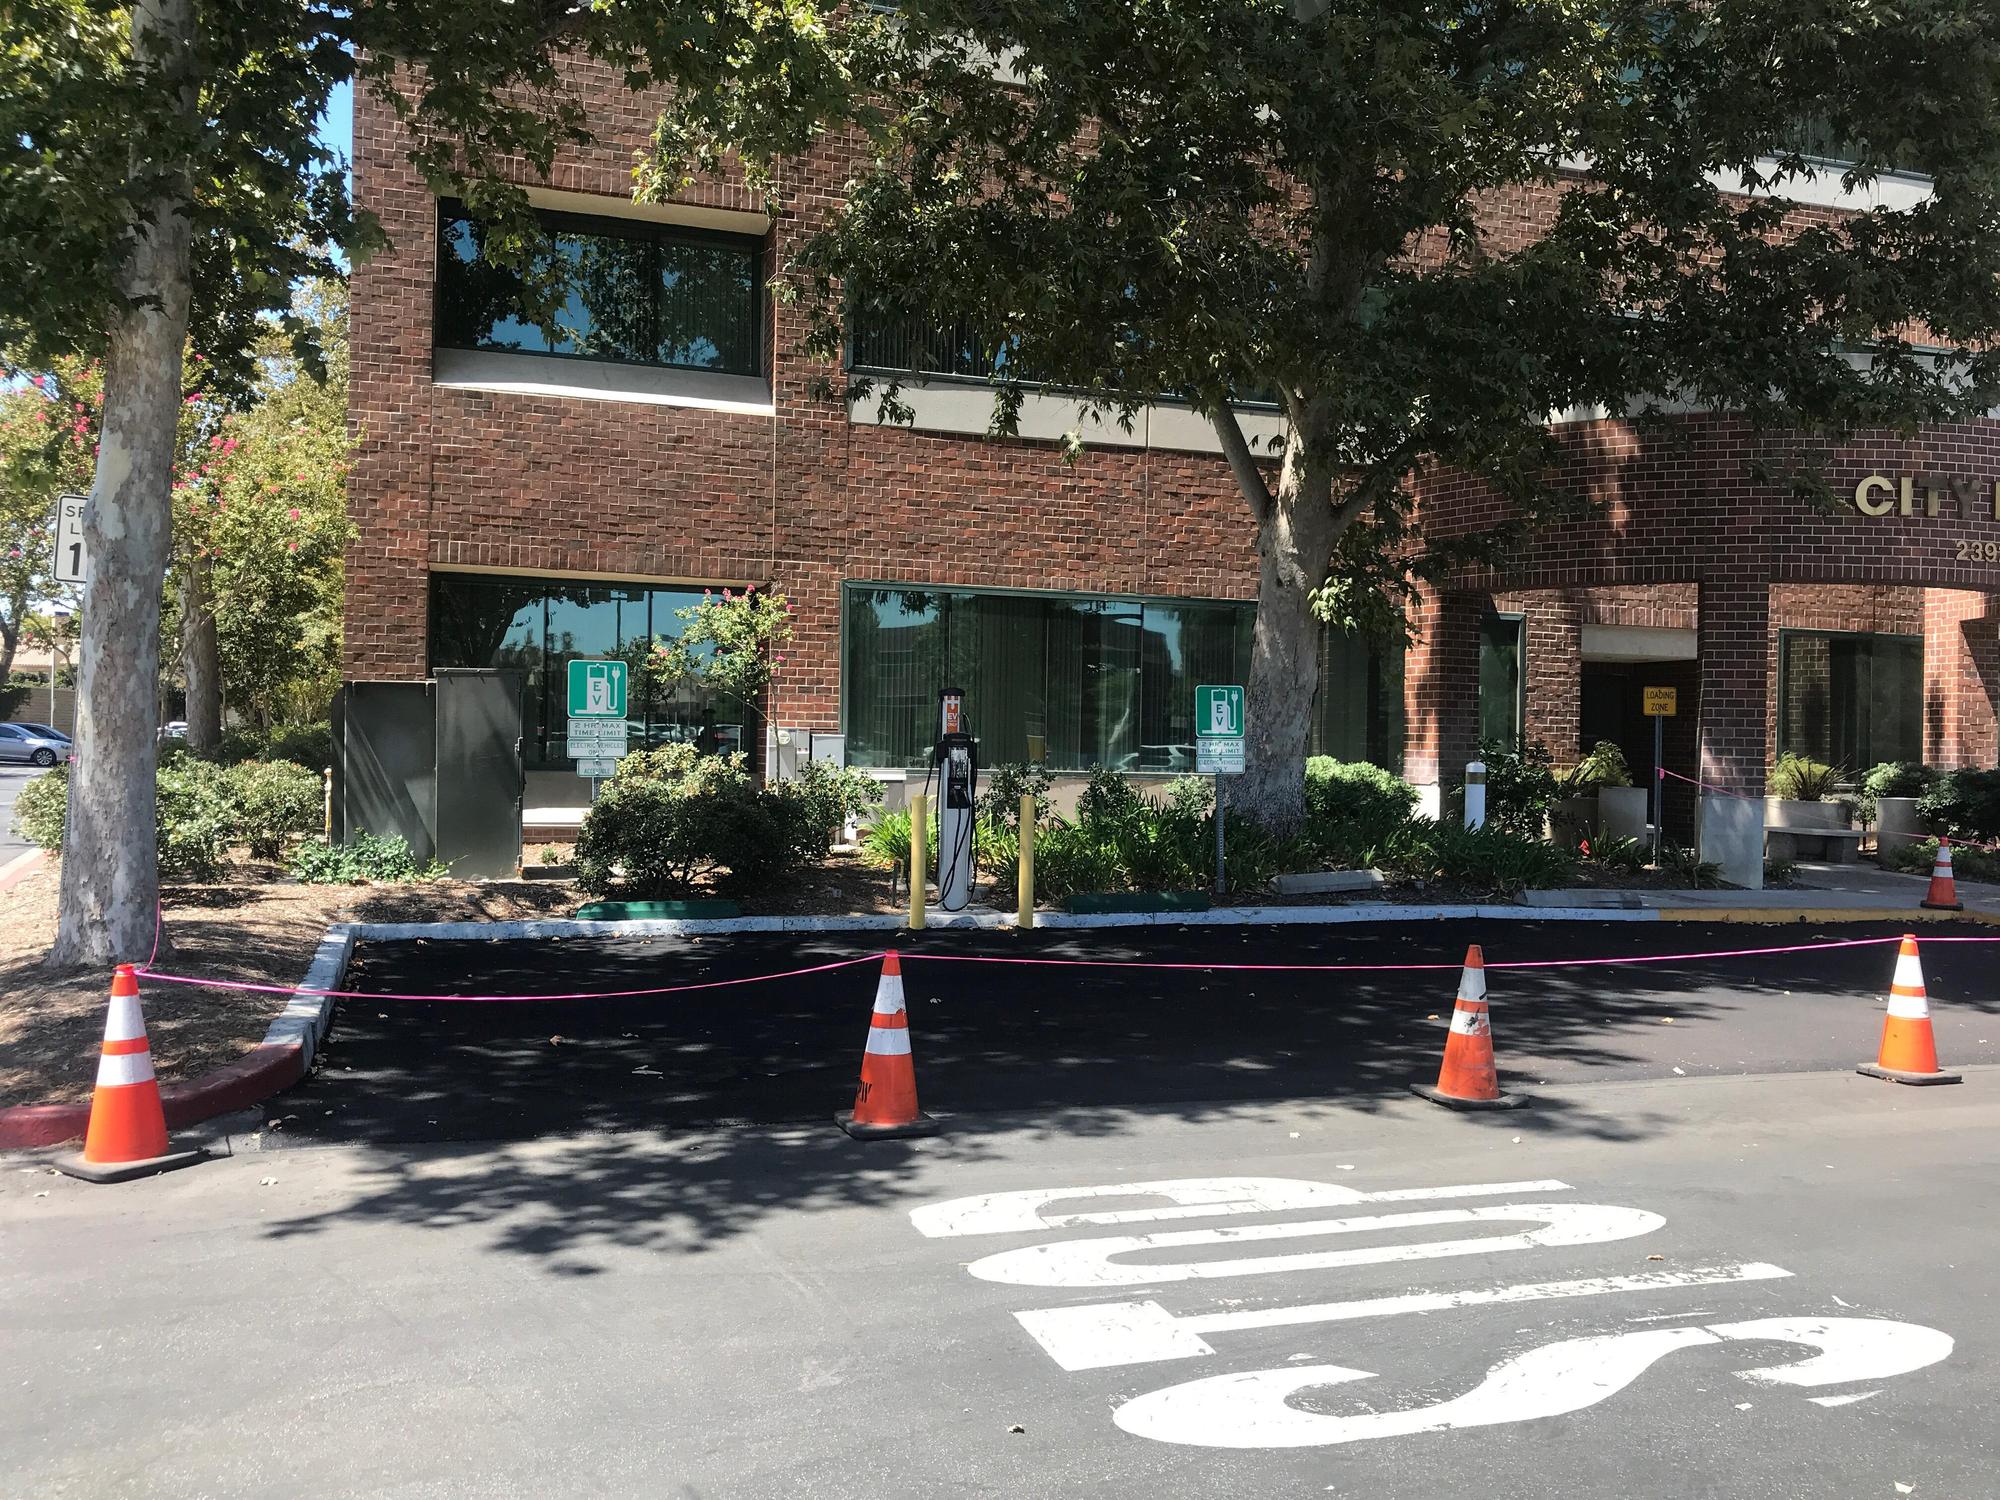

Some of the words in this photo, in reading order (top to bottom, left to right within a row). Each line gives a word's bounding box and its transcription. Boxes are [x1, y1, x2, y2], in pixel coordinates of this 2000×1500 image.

[1855, 475, 1982, 520] CITY
[69, 542, 81, 576] 1
[1956, 541, 2000, 562] 239
[592, 681, 602, 706] EV
[1646, 690, 1674, 700] LOADING
[947, 712, 958, 720] EV
[1215, 704, 1224, 726] EV
[1650, 702, 1669, 711] ZONE
[907, 1175, 1955, 1450] STOP
